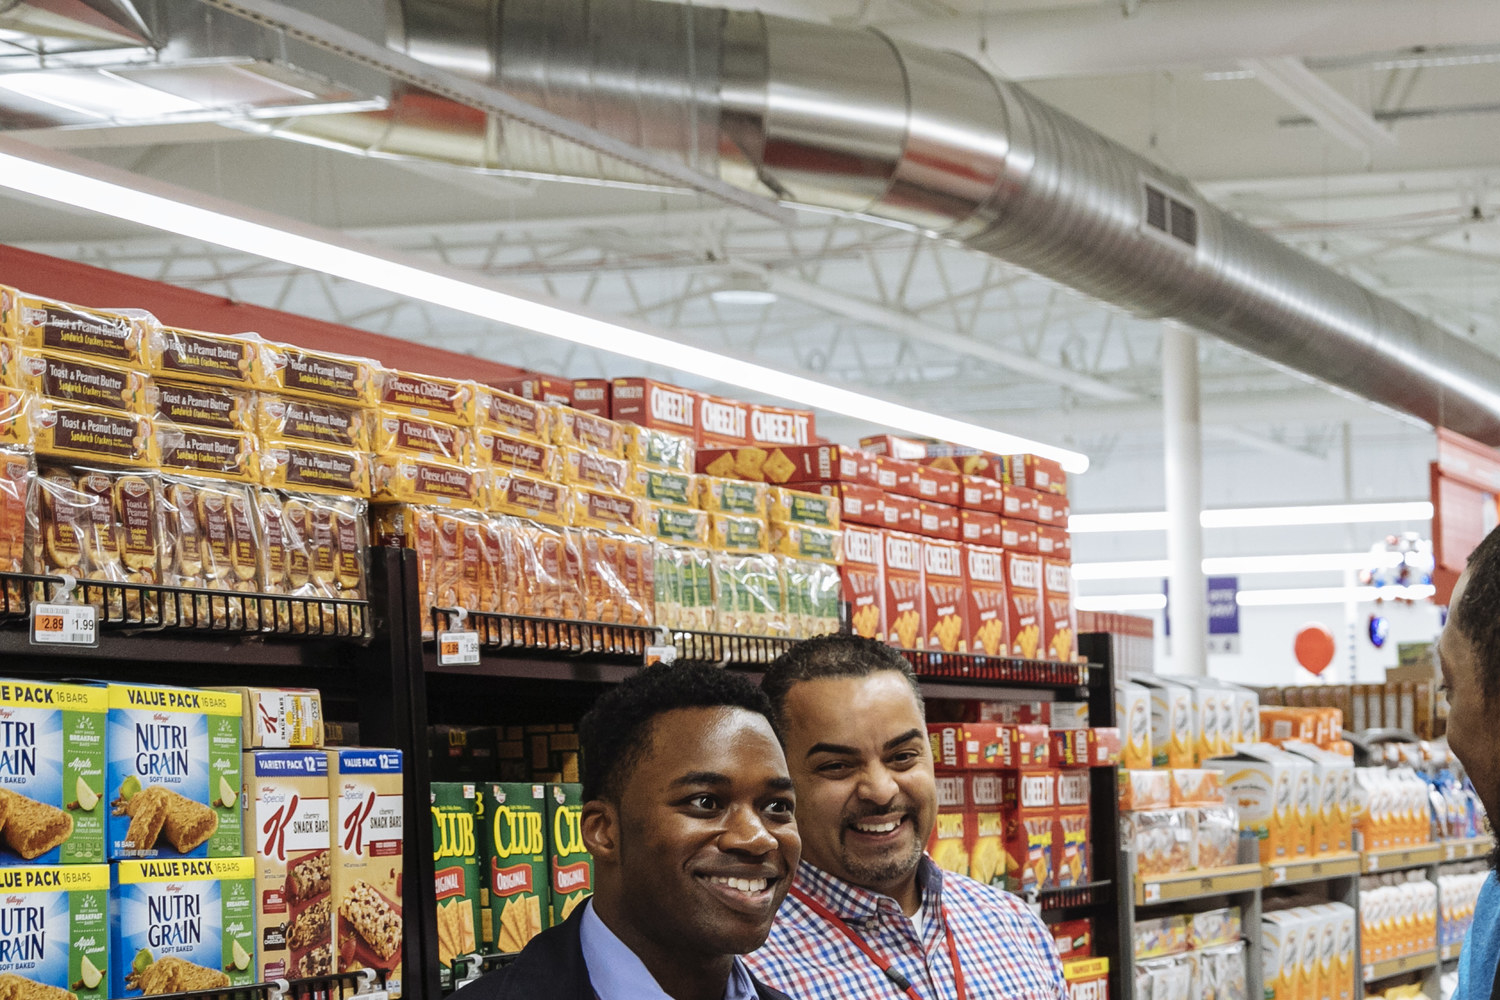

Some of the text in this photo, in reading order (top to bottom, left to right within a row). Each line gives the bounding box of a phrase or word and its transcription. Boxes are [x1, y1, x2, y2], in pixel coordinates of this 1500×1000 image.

[194, 343, 238, 359] Peanut Butter
[50, 364, 68, 379] Toast
[76, 370, 100, 385] Peanut
[101, 375, 122, 389] Butter
[59, 380, 82, 393] Sandwich
[163, 392, 230, 411] Toast Peanut Butter
[61, 416, 133, 437] Toast Peanut Butter
[71, 431, 93, 443] Sandwich
[192, 439, 235, 454] Peanut Butter
[127, 508, 148, 518] Peanut
[129, 517, 148, 525] Butter
[42, 616, 94, 631] $2.89 $1.99
[15, 687, 54, 704] PACK
[56, 692, 65, 702] 16
[66, 692, 88, 703] BARS
[128, 689, 227, 708] VALUE PACK 16 BARS
[136, 722, 187, 752] NUTRI
[68, 757, 92, 772] Apple
[136, 750, 188, 776] GRAIN
[212, 758, 231, 773] Apple
[259, 757, 316, 772] VARIETY PACK 12
[344, 759, 361, 767] VALUE
[362, 758, 377, 767] PACK
[379, 755, 388, 768] 12
[164, 776, 181, 784] BAKED
[263, 794, 285, 803] Special
[344, 791, 363, 799] Special
[263, 795, 298, 861] K
[293, 820, 328, 834] SNACK BARS
[344, 791, 375, 855] K
[370, 816, 401, 829] SNACK BARS
[494, 805, 543, 858] CLUB
[141, 861, 240, 877] VALUE PACK 16 BARS
[26, 871, 61, 886] PACK
[63, 873, 71, 883] 16
[72, 873, 91, 882] BARS
[497, 870, 527, 890] ORIGINAL
[558, 869, 585, 888] ORIGINAL
[148, 894, 200, 926] NUTRI
[1, 907, 44, 936] UTRI
[148, 917, 201, 947] GRAIN
[226, 922, 244, 937] Apple
[74, 936, 96, 951] Apple
[174, 945, 193, 953] BAKED
[16, 962, 35, 970] BAKED
